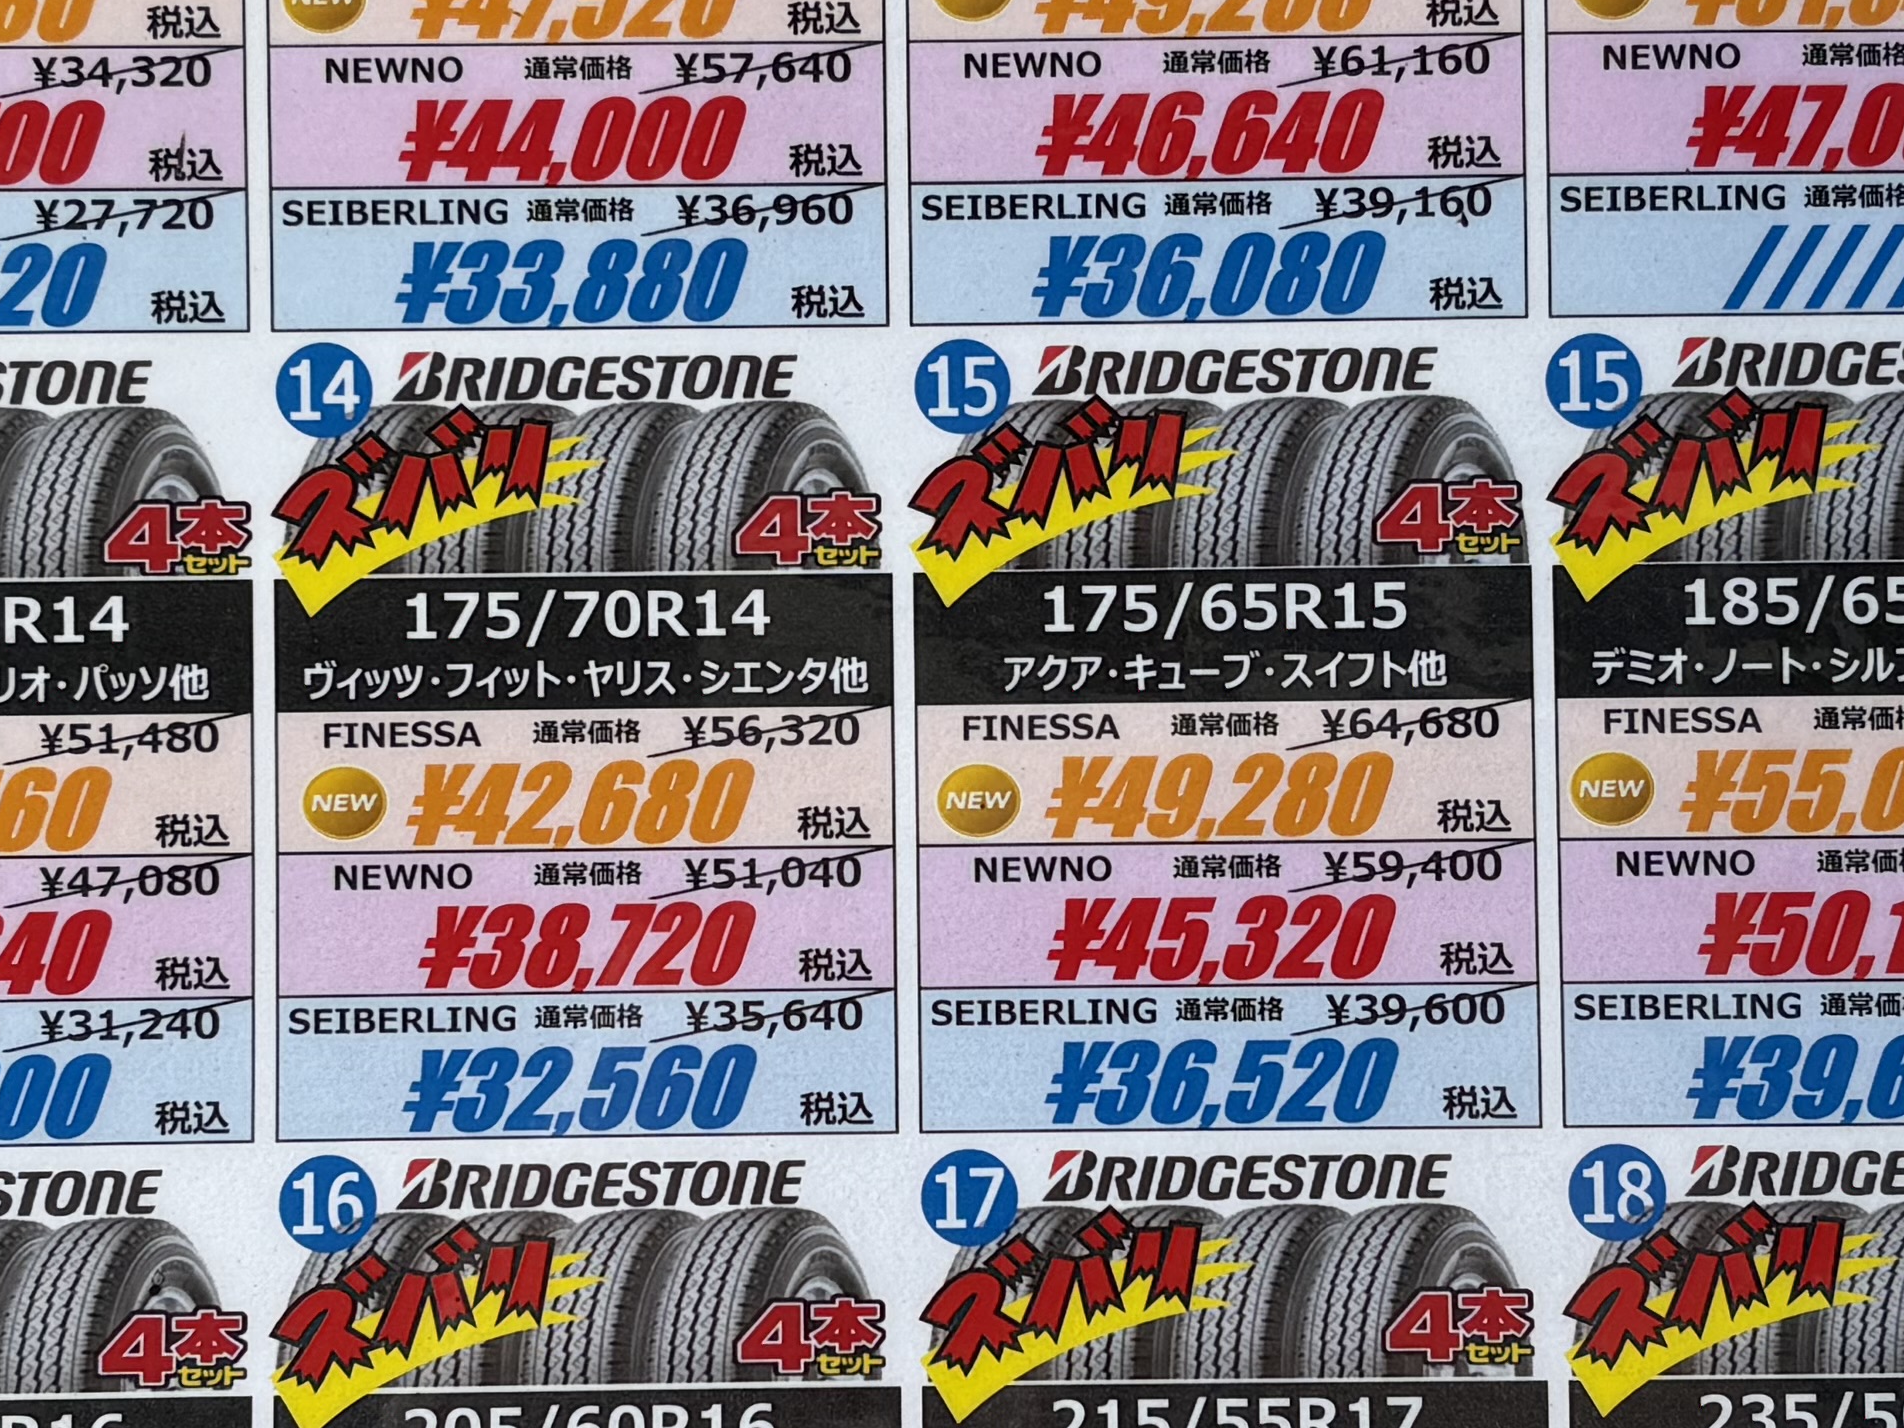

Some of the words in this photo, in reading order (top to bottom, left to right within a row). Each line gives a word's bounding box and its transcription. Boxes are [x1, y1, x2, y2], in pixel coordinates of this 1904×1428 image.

[326, 56, 463, 83] NEWNO
[674, 50, 853, 88] ¥57,640
[400, 96, 746, 188] ¥44,000
[922, 192, 1145, 220] SEIBERLING
[1314, 185, 1492, 221] ¥39,160
[396, 238, 748, 330] ¥33,880
[1032, 231, 1386, 323] ¥36,080
[407, 589, 770, 647] 175/70R14
[1044, 582, 1406, 639] 175/65R15
[408, 760, 754, 851] ¥42,680
[1047, 753, 1394, 844] ¥49,280
[975, 856, 1112, 882] NEWNO
[1323, 848, 1503, 885] ¥59,400
[1048, 895, 1396, 987] ¥45,320
[39, 1006, 221, 1044] ¥31,240
[403, 1044, 756, 1137] ¥32,560
[1045, 1038, 1399, 1130] ¥36,520
[1583, 1161, 1653, 1223] 18
